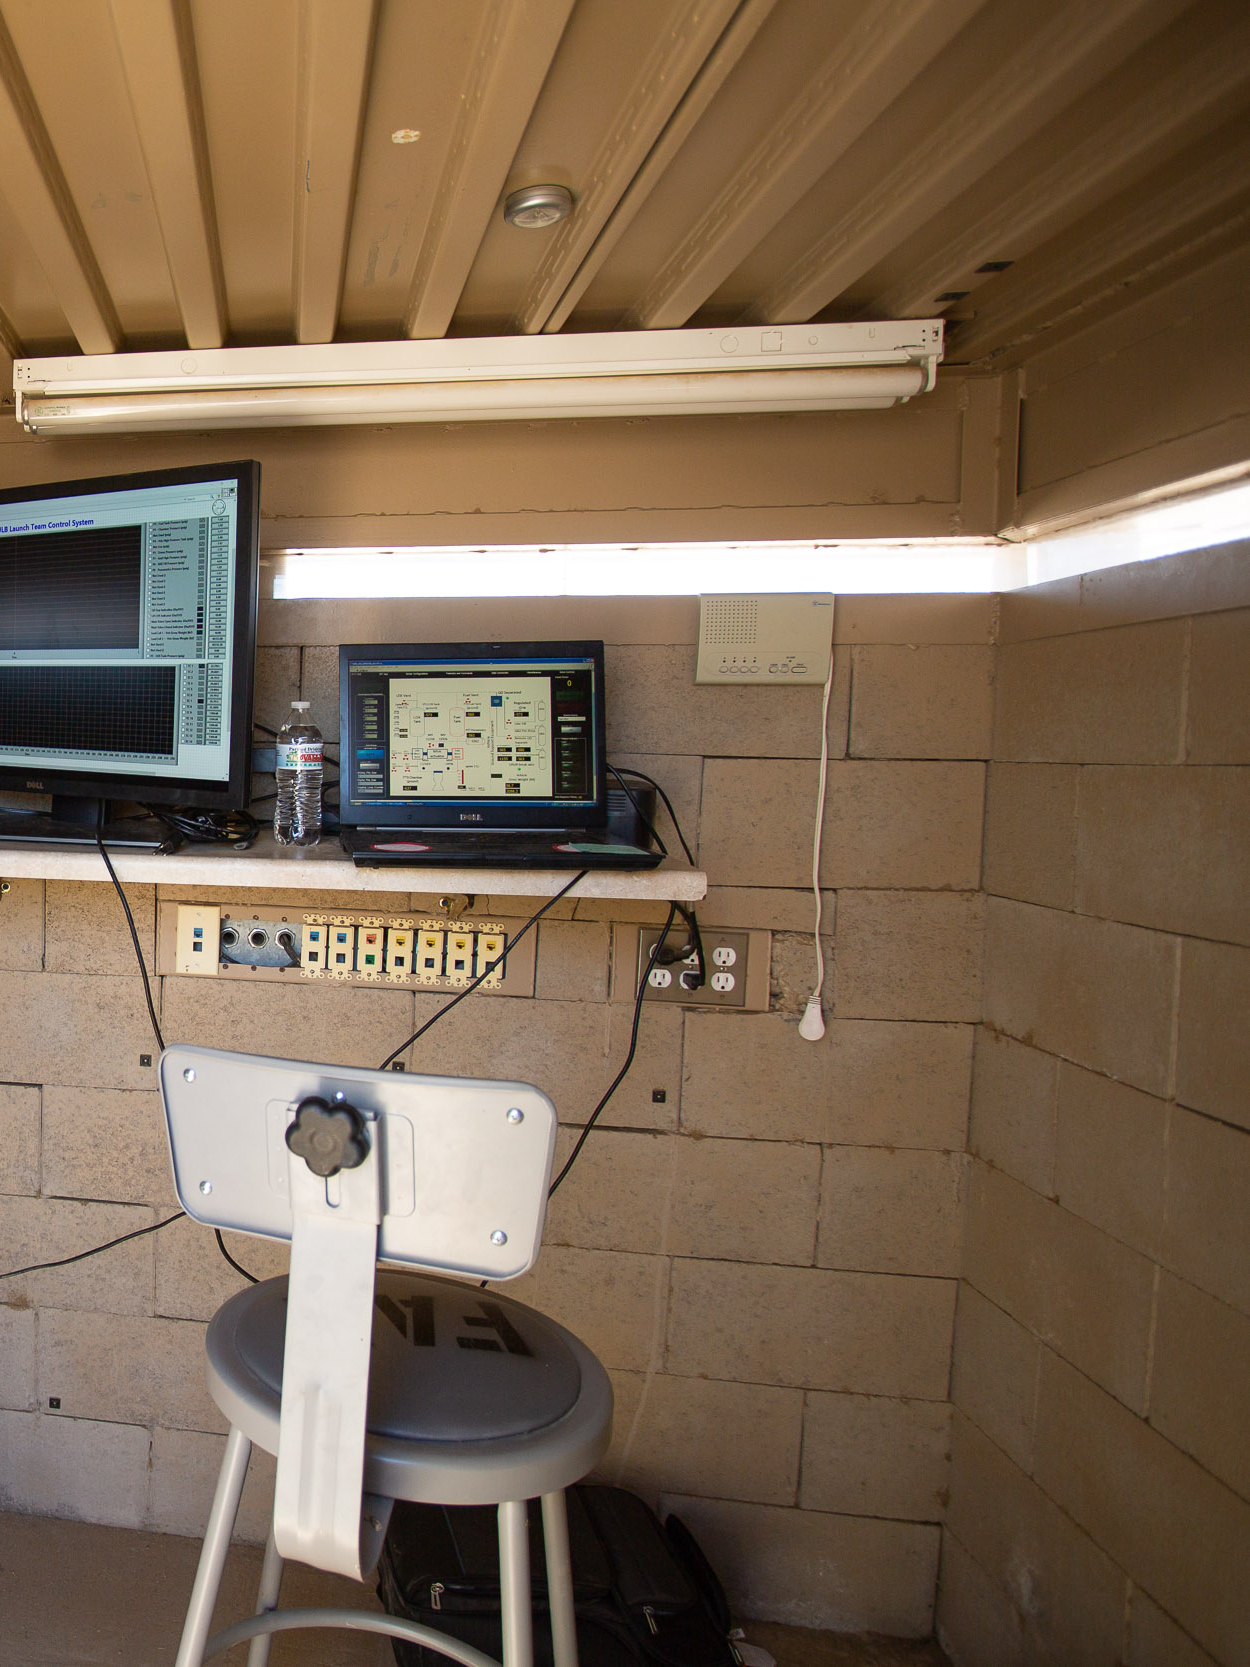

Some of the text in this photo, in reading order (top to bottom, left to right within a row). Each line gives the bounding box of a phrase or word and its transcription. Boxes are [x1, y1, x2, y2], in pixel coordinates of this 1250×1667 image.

[10, 524, 30, 533] Launch
[31, 523, 47, 531] Team
[48, 520, 71, 529] Control
[72, 519, 94, 528] System
[26, 781, 44, 790] DELL
[460, 813, 484, 821] DELL
